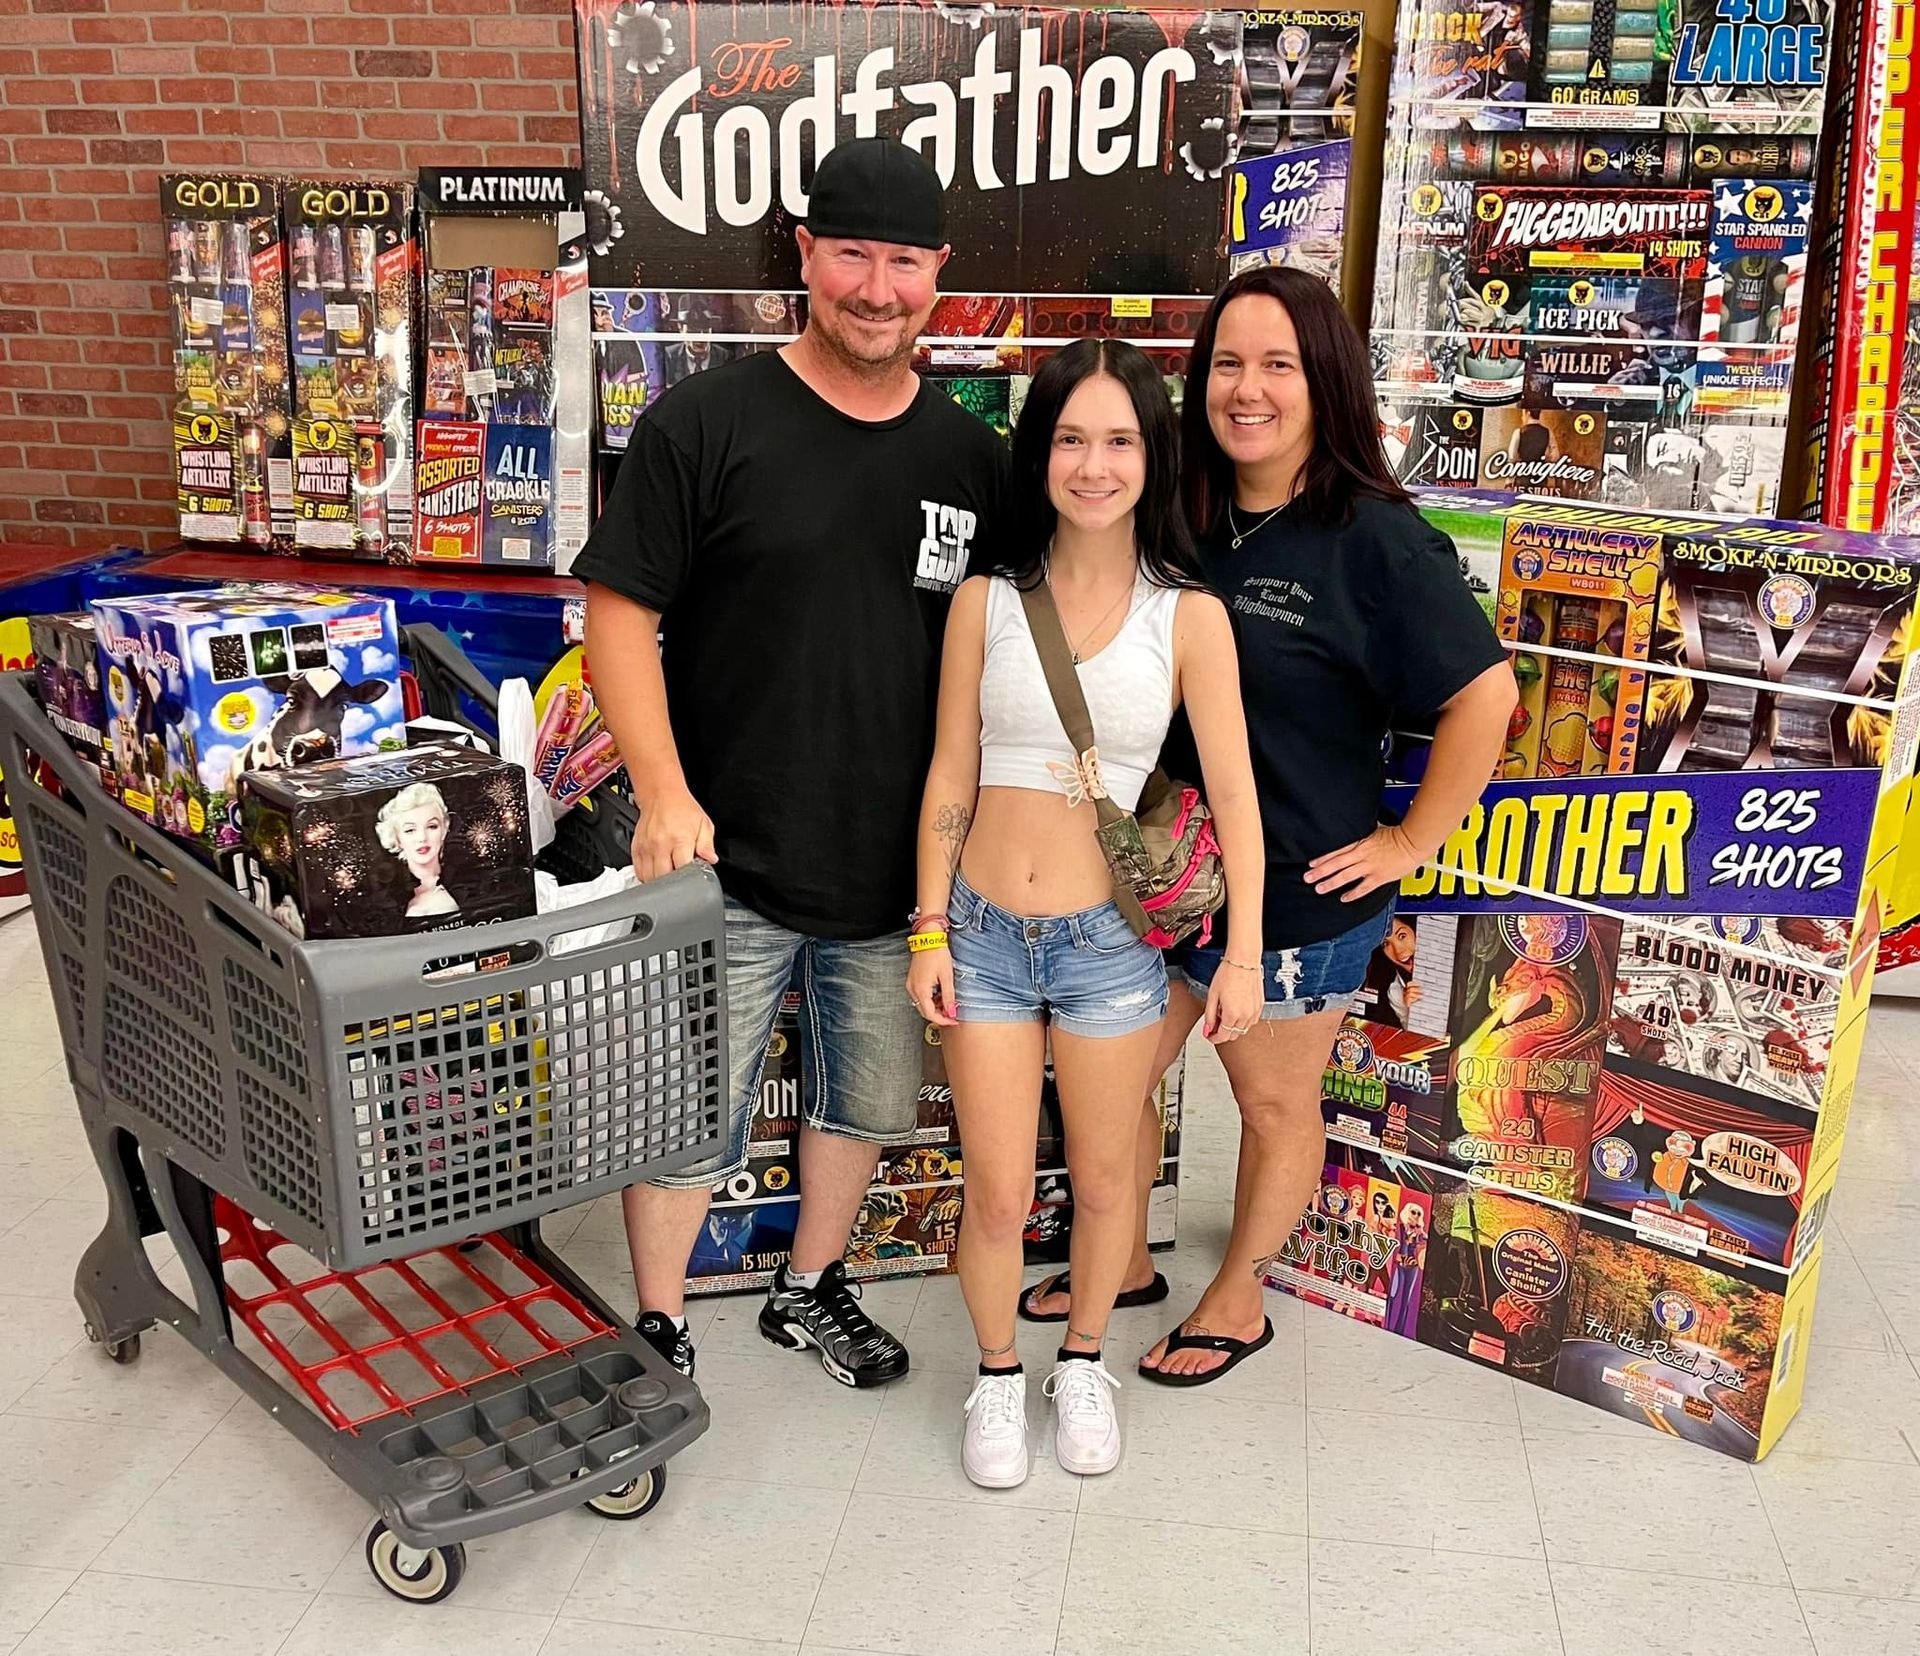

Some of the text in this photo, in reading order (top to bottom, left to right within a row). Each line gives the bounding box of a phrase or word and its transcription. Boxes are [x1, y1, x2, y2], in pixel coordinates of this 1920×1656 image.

[1243, 11, 1361, 26] OKE-N-MIRRORS
[1672, 24, 1824, 85] LARGE
[708, 38, 801, 98] The
[1551, 87, 1639, 106] 60 GRAMS
[635, 28, 1197, 236] Godfather
[440, 176, 566, 202] PLATINUM
[1271, 158, 1320, 194] 825
[175, 181, 261, 208] GOLD
[302, 189, 390, 217] GOLD
[1491, 200, 1709, 248] FUGGEDABOUTIT!!!
[1715, 223, 1807, 237] STAR SPANGLED
[1649, 240, 1702, 258] 14 SHOTS
[1734, 237, 1784, 250] CANNON
[1538, 308, 1621, 331] ICE PICK
[1540, 352, 1612, 376] WILLIE
[1726, 365, 1763, 376] TWELVE
[1667, 384, 1681, 398] 16
[1703, 375, 1785, 387] UNIQUE EFFECTS
[180, 450, 231, 469] WHISTLING
[297, 456, 348, 475] WHISTLING
[496, 444, 539, 480] ALL
[1437, 447, 1477, 480] DON
[1484, 451, 1596, 484] Consigliere
[181, 468, 231, 490] ARTILLERY
[297, 473, 348, 494] ARTILLERY
[417, 457, 480, 493] ASSORTED
[188, 496, 233, 513] 6 SHOTS
[418, 480, 480, 517] CANISTERS
[486, 480, 550, 503] CRACKLE
[303, 503, 349, 519] 6 SHOTS
[490, 504, 544, 517] CANISTERS
[424, 522, 471, 534] 6 SHOTS
[920, 500, 977, 548] TOP
[1511, 522, 1658, 558] ARTILLERY
[916, 537, 971, 585] GUN
[1547, 549, 1635, 579] SHELL
[1673, 541, 1913, 586] SMOKE-N-MIRRORS
[1243, 576, 1314, 604] Support Your
[1260, 588, 1289, 604] Local
[1571, 577, 1606, 591] WB011
[1233, 595, 1305, 627] Highwaymen
[1734, 788, 1822, 834] 825
[1707, 842, 1844, 890] SHOTS
[1634, 935, 1827, 1002] BLOOD MONEY
[1641, 1000, 1673, 1029] 49
[1641, 1026, 1668, 1041] SHOTS
[1374, 1058, 1432, 1094] YOUR
[1455, 1056, 1601, 1094] QUEST
[1501, 1118, 1535, 1138] 24
[1456, 1142, 1574, 1168] CANISTER
[1728, 1136, 1777, 1168] HIGH
[1468, 1166, 1557, 1192] SHELLS
[1708, 1151, 1795, 1195] FALUTIN'
[935, 1223, 956, 1240] 15
[926, 1238, 956, 1254] SHOTS
[1522, 1250, 1539, 1261] The
[741, 1254, 755, 1271] 15
[1501, 1251, 1559, 1274] Original Maker
[1504, 1266, 1551, 1288] Canister
[1509, 1277, 1543, 1295] Shells
[1584, 1314, 1748, 1392] Hit the Road, Jack
